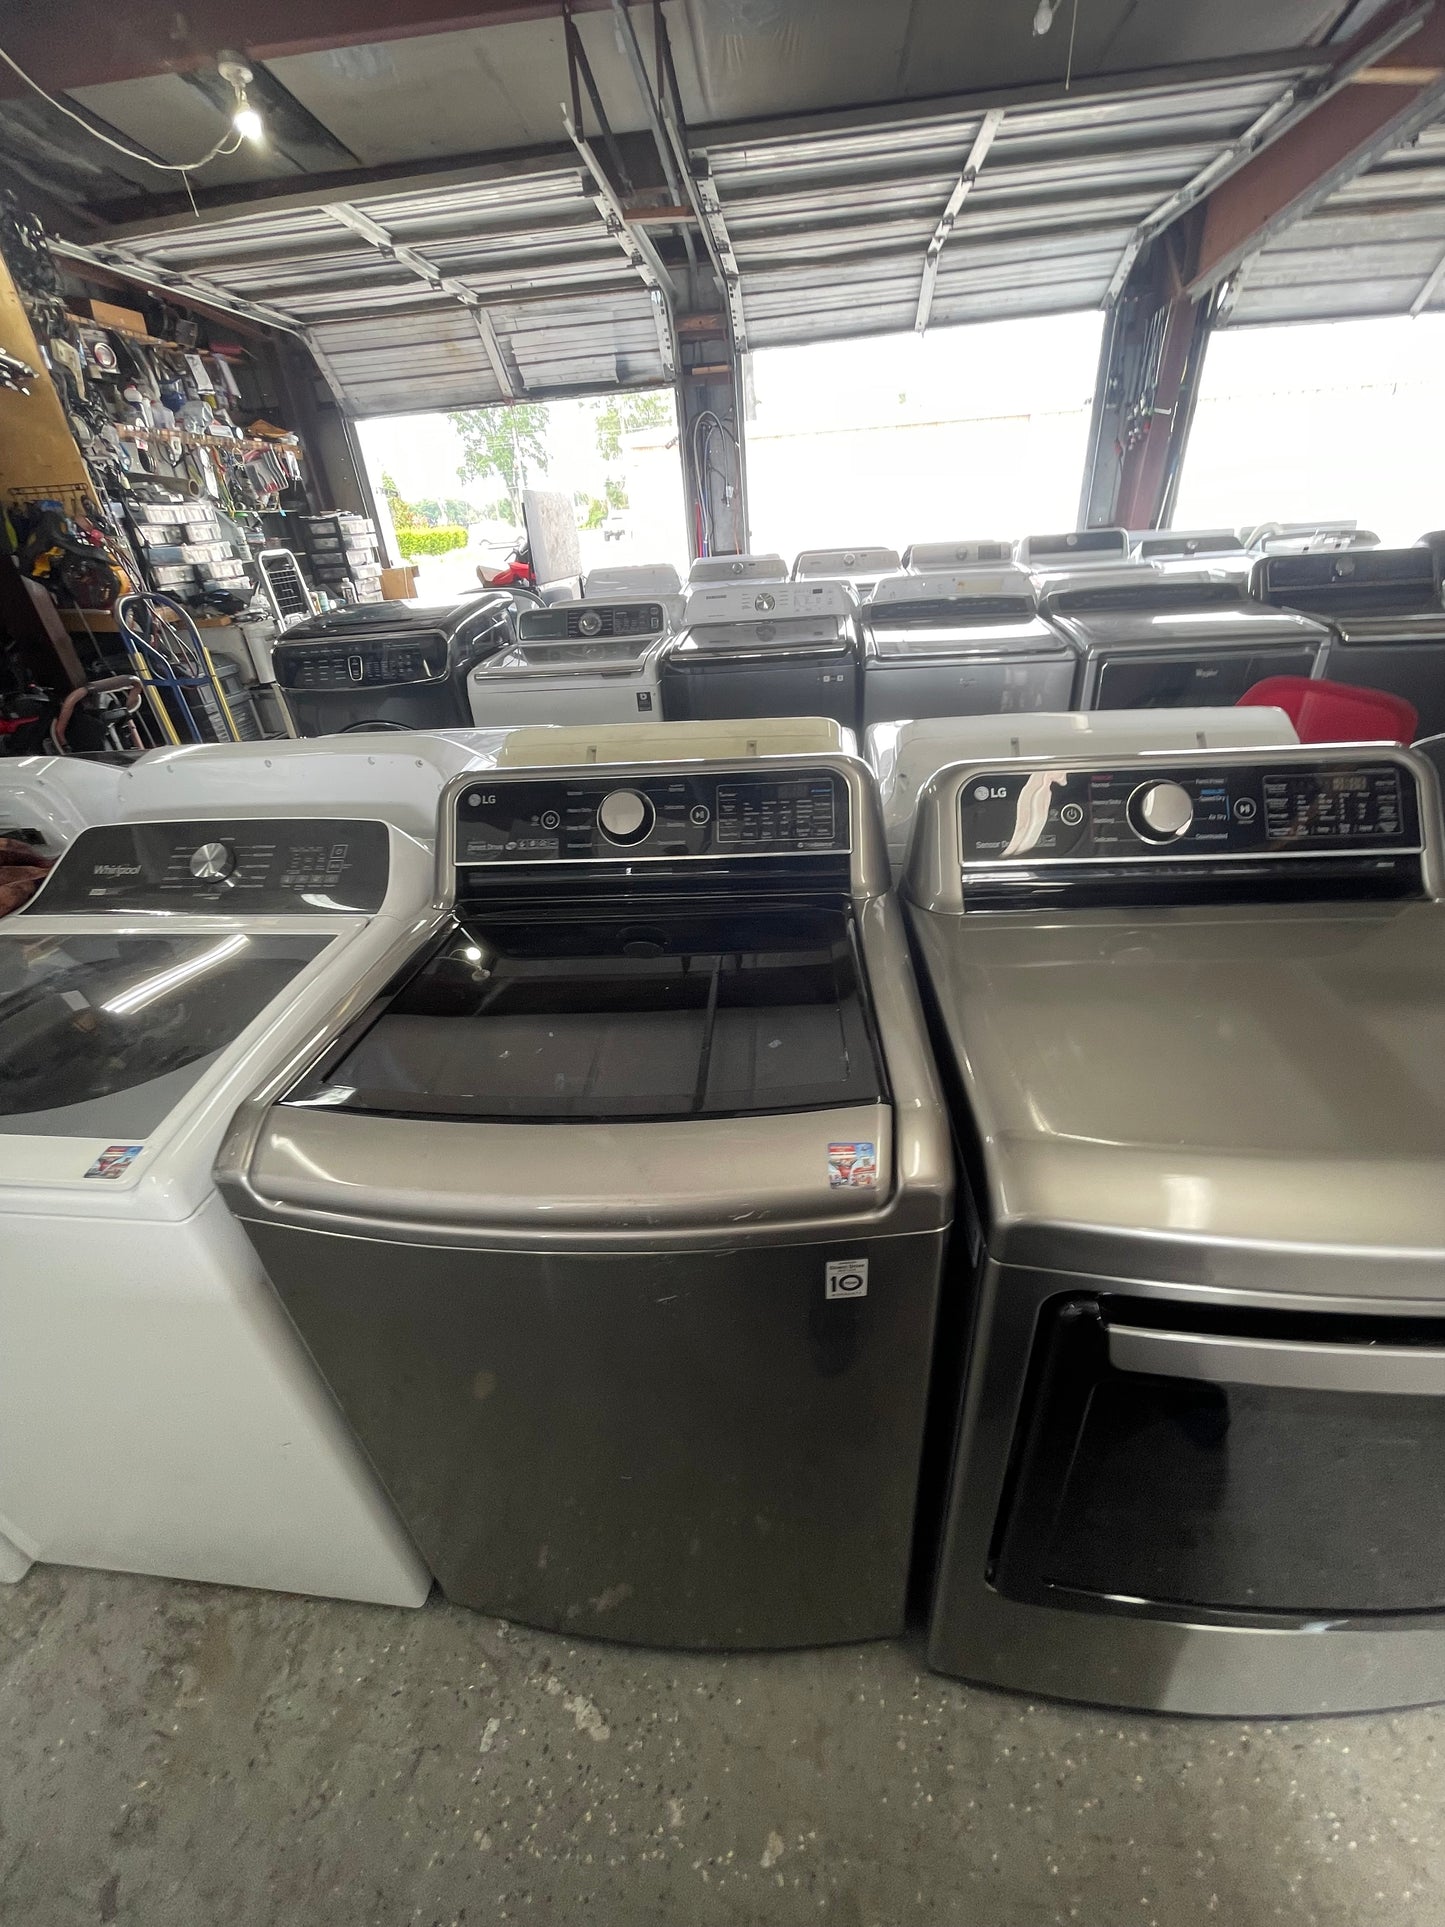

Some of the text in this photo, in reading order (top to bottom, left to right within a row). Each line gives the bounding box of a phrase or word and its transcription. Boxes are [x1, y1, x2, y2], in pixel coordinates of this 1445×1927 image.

[990, 787, 1007, 798] LG
[482, 795, 496, 804] LG
[975, 841, 1000, 849] Sensor
[93, 865, 141, 879] Whirlpool
